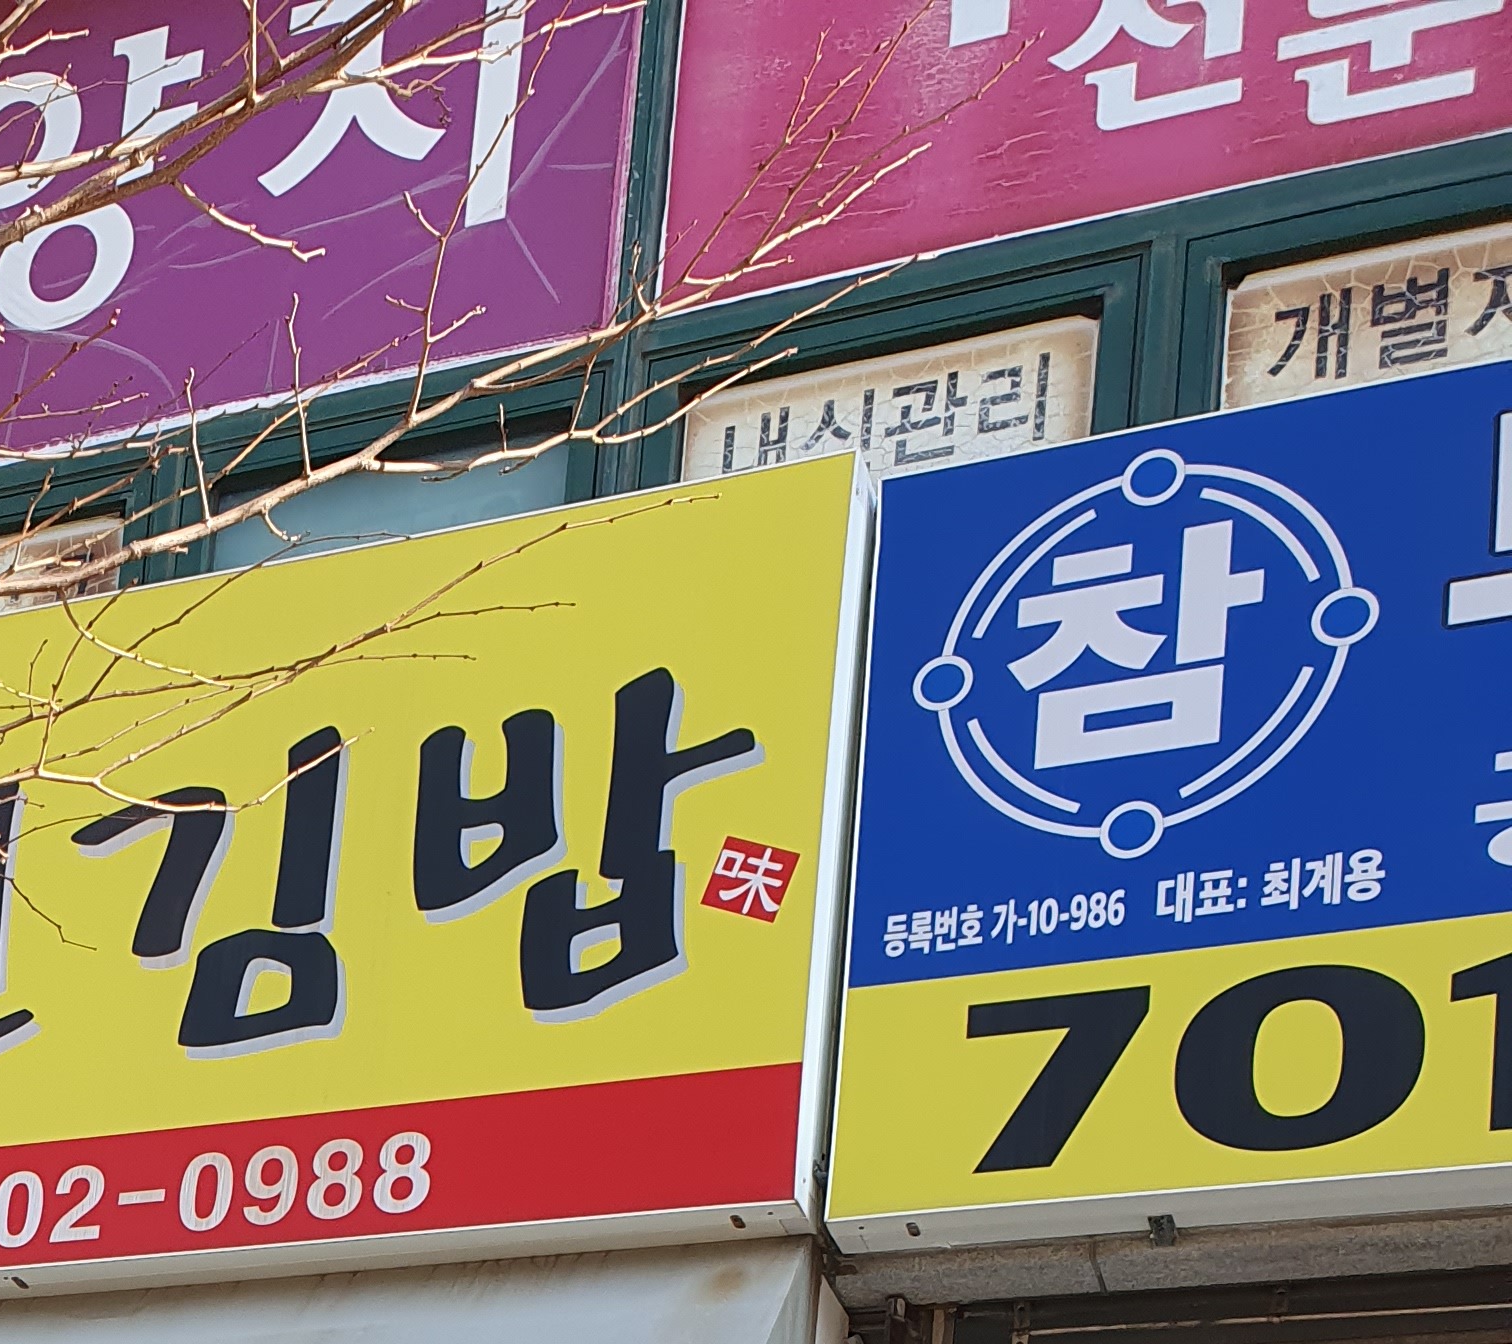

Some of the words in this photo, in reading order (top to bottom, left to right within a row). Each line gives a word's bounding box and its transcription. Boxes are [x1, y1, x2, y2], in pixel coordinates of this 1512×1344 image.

[1007, 520, 1265, 770] 참
[884, 903, 983, 958] 등록번호
[991, 889, 1125, 944] 가-10-986
[1260, 848, 1386, 911] 최계용
